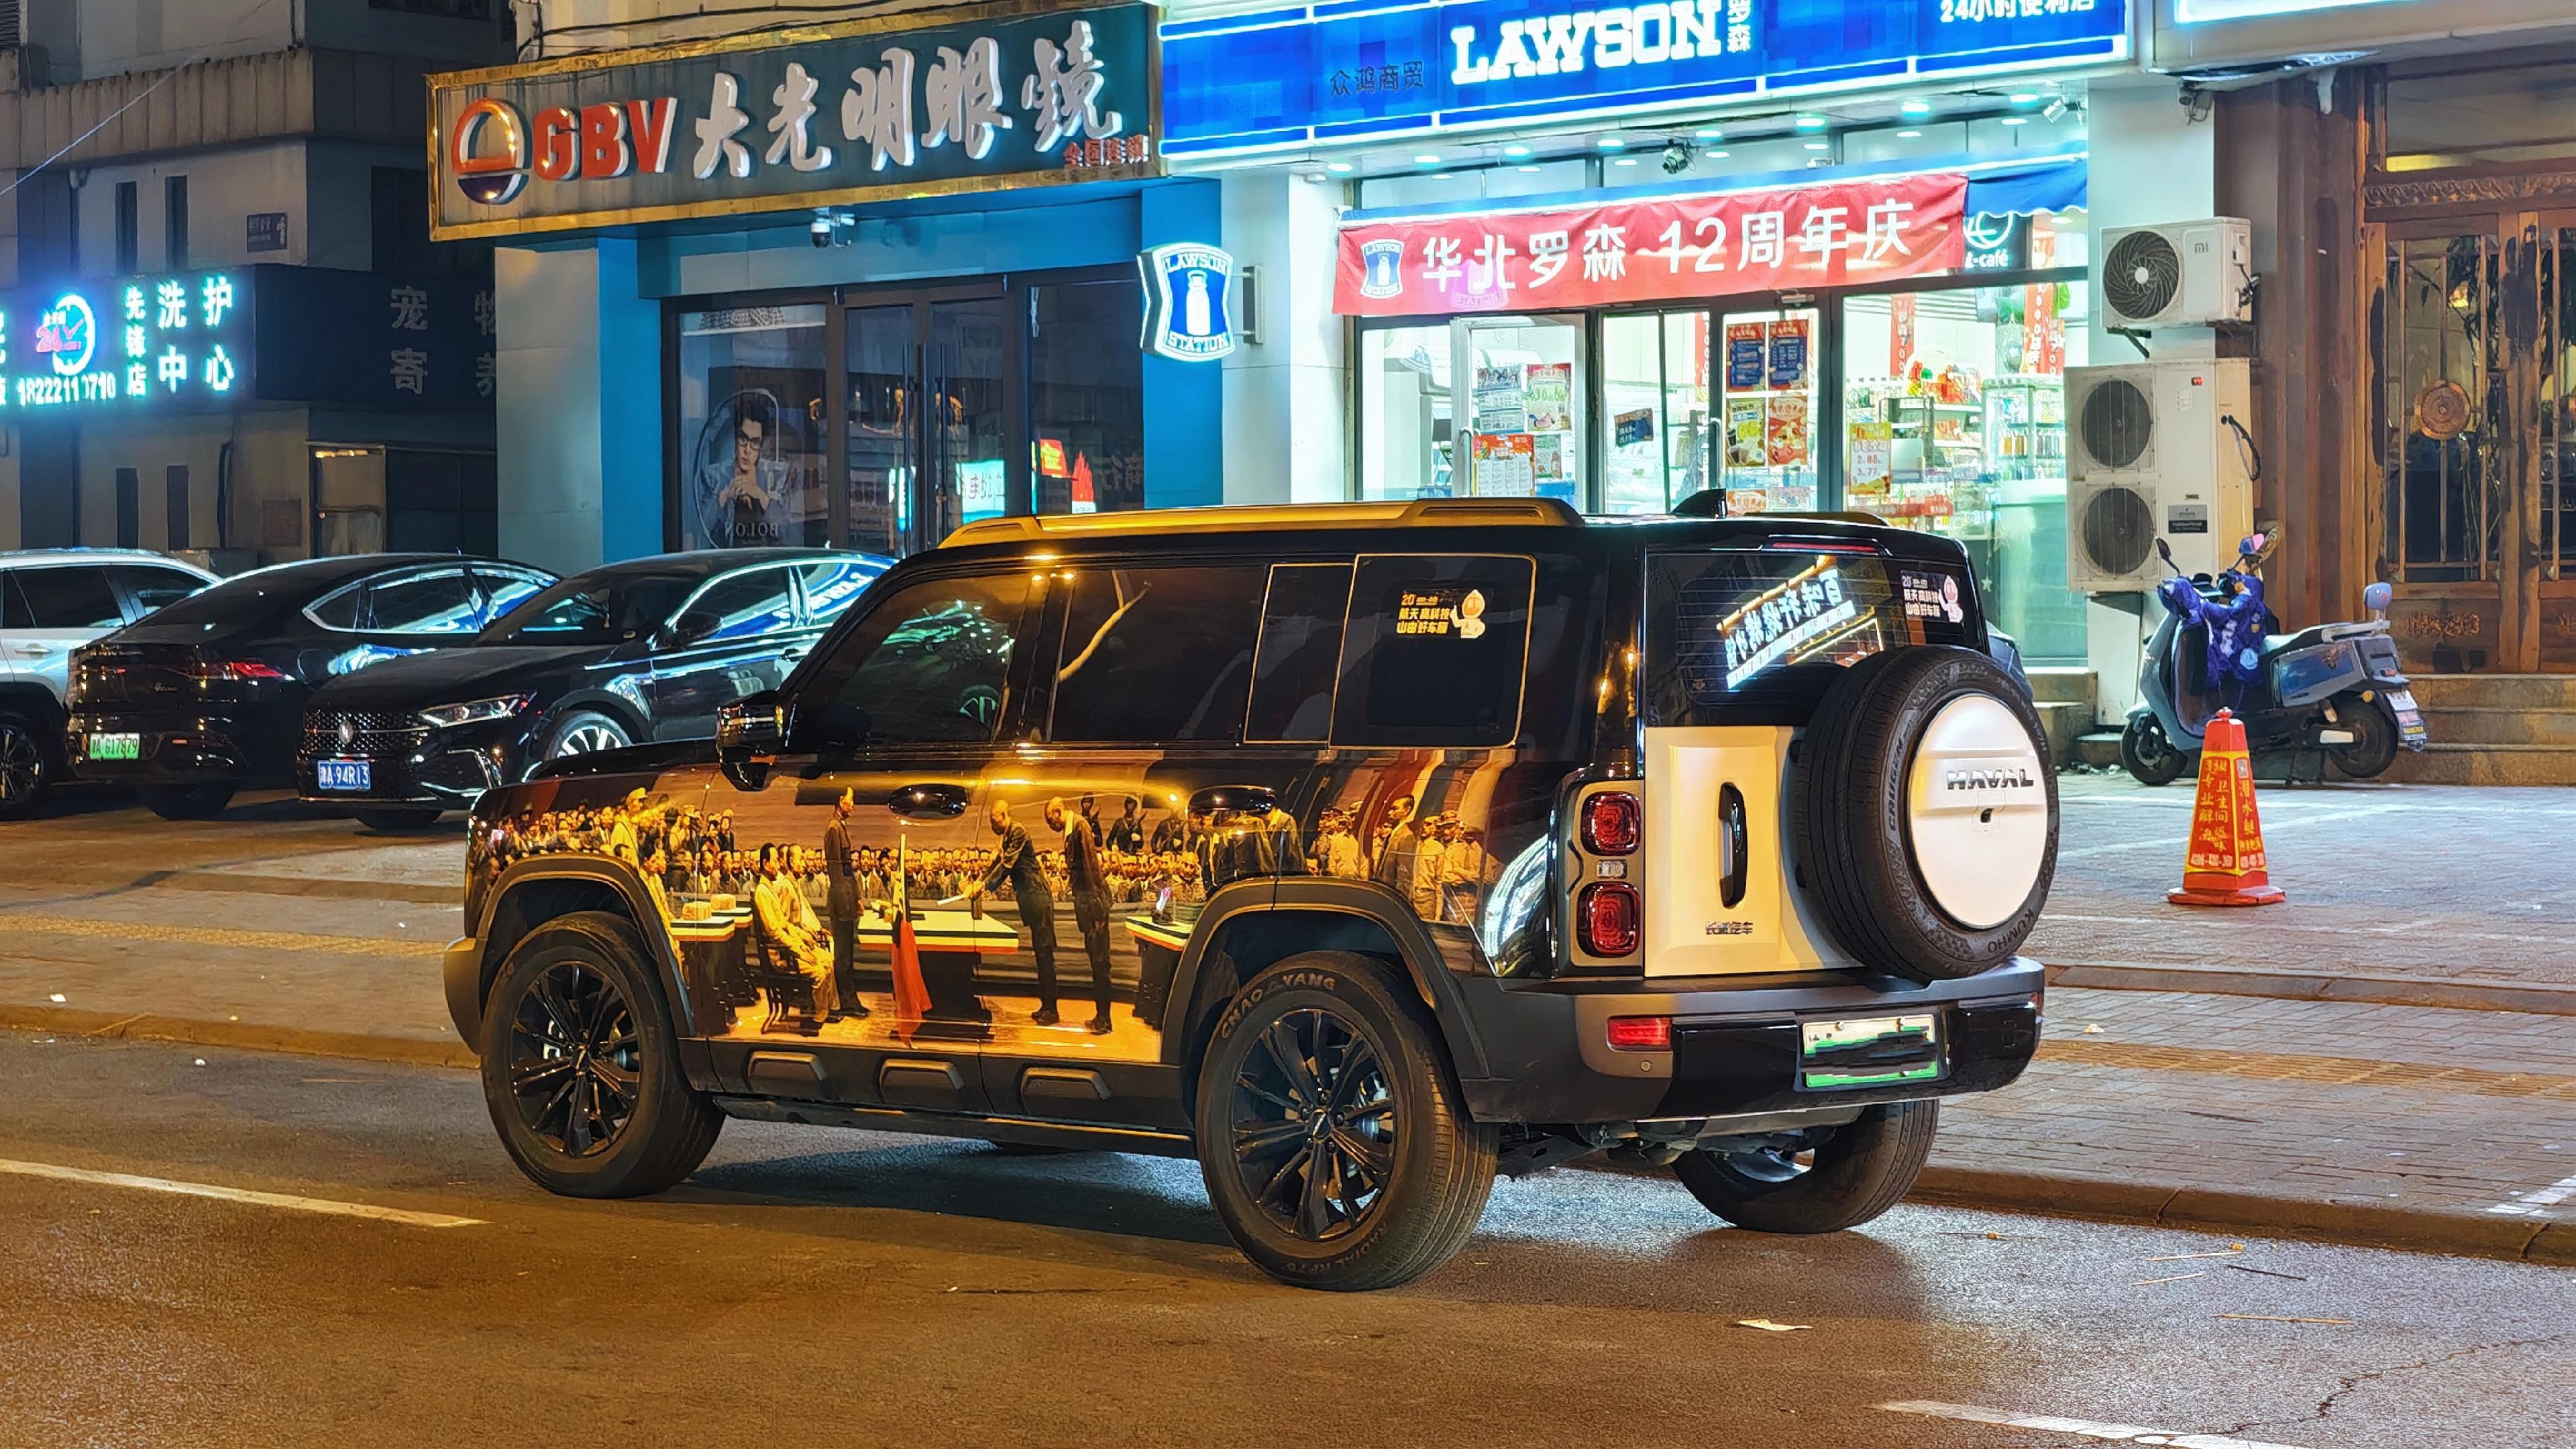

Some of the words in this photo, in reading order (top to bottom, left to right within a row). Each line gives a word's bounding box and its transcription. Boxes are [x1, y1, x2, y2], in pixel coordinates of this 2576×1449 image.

[1450, 0, 1721, 85] LAWSON
[1727, 0, 1751, 53] 罗森
[533, 97, 678, 181] GBV
[694, 19, 1123, 179] 大光明眼镜
[1164, 252, 1228, 276] LAWSON
[158, 276, 233, 329] 洗护
[1167, 331, 1230, 352] STATION
[158, 344, 234, 394] 中心
[1947, 767, 2034, 790] HAVAL
[1986, 908, 2035, 953] KUMHO
[1221, 986, 1263, 1039] CHAO
[1282, 972, 1336, 993] YANG
